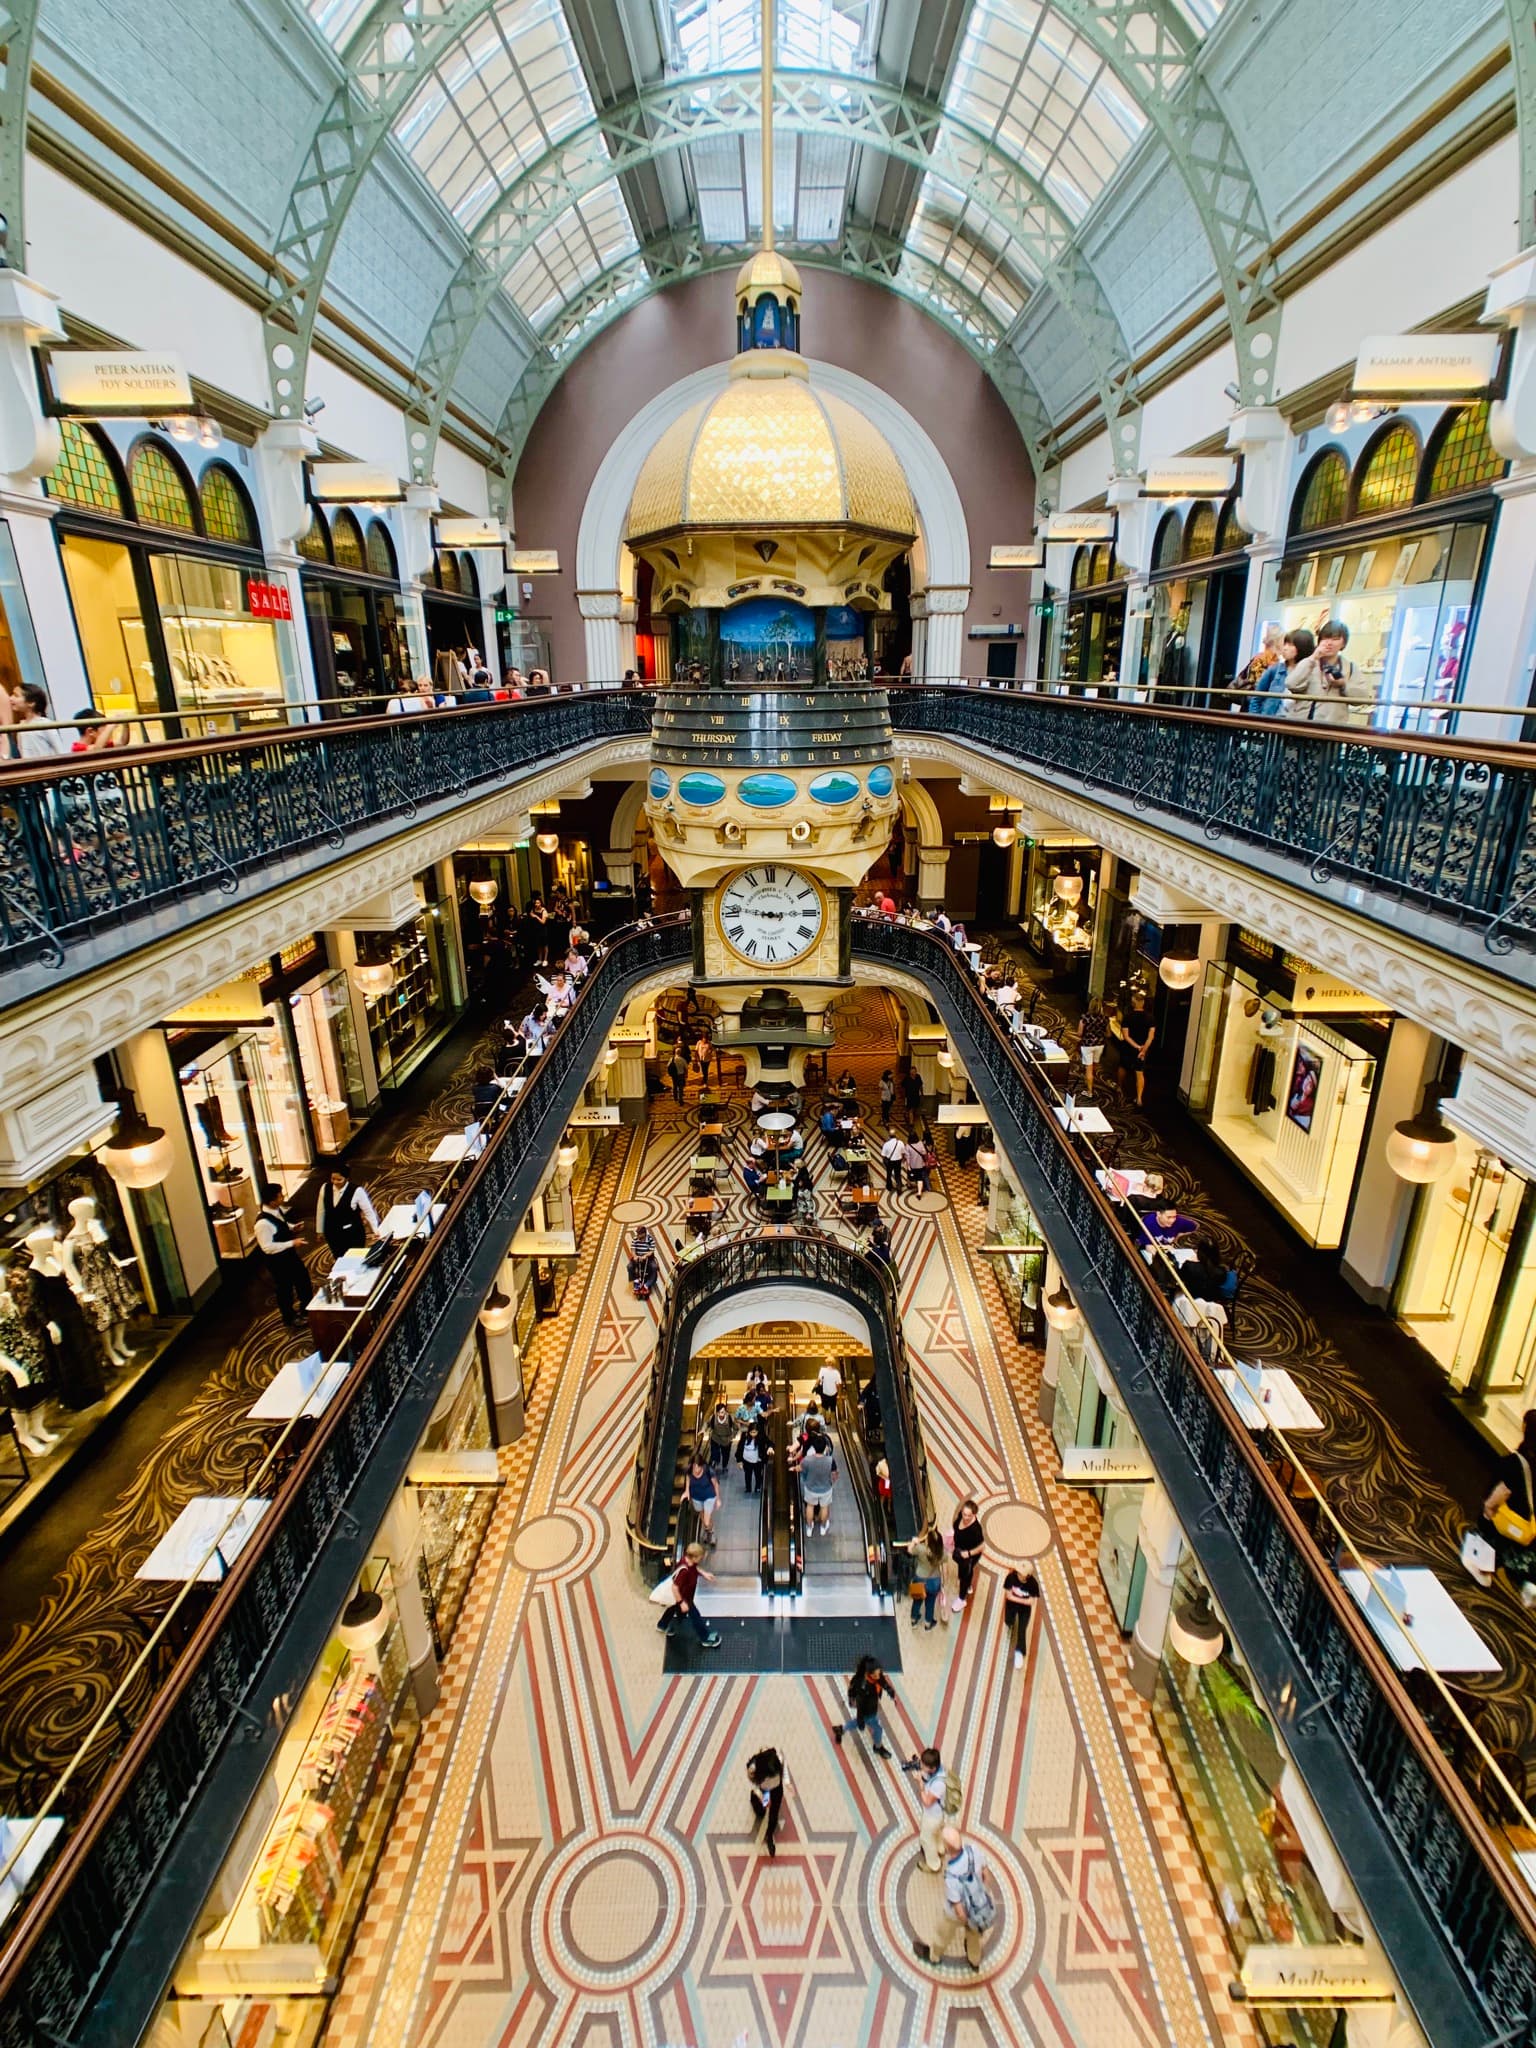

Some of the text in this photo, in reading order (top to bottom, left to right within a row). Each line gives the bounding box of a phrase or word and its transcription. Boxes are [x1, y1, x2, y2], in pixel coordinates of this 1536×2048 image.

[94, 364, 176, 375] PETER NATHAN
[100, 379, 177, 390] TOY SOLDIERS
[251, 592, 289, 612] SALE
[741, 697, 750, 706] III
[806, 696, 816, 706] IV
[710, 715, 725, 725] VIII
[779, 715, 790, 725] IX
[691, 732, 842, 744] THURSDAY FRIDAY
[682, 752, 687, 760] 6
[702, 752, 708, 760] 7
[727, 753, 733, 762] 8
[753, 753, 760, 762] 9
[780, 753, 789, 762] 10
[808, 752, 815, 761] 11
[833, 751, 840, 760] 12
[1320, 989, 1350, 998] HELEN
[1081, 1457, 1139, 1473] Mulberry
[1276, 1969, 1370, 1987] Mulberry
